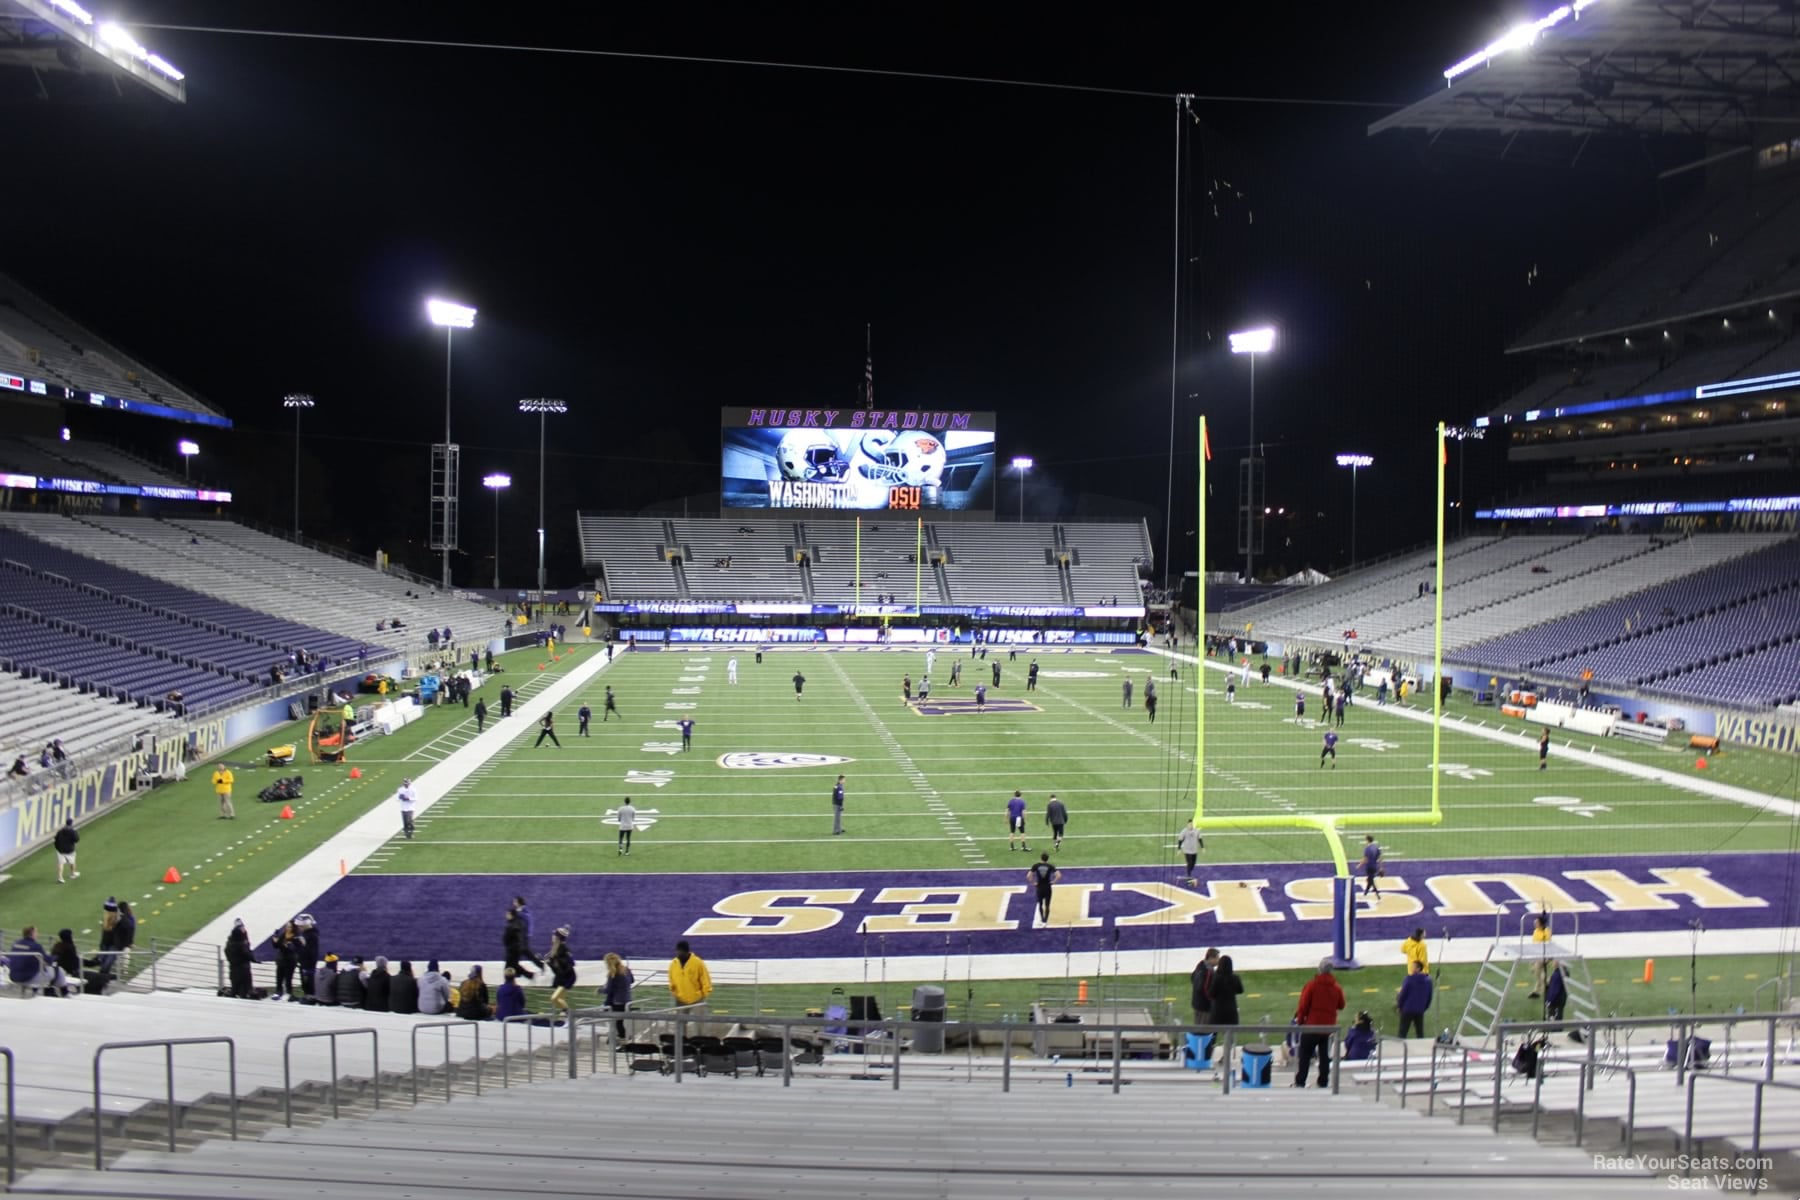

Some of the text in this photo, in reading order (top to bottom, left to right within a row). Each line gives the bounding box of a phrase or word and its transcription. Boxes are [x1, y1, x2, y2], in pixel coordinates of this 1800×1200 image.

[748, 410, 971, 429] HUSKY STADIUM
[768, 481, 858, 501] WASHINGTON
[889, 487, 921, 504] OSU
[16, 769, 105, 848] MIGHTY
[196, 719, 226, 754] MEN
[683, 867, 1769, 935] HUSKIES
